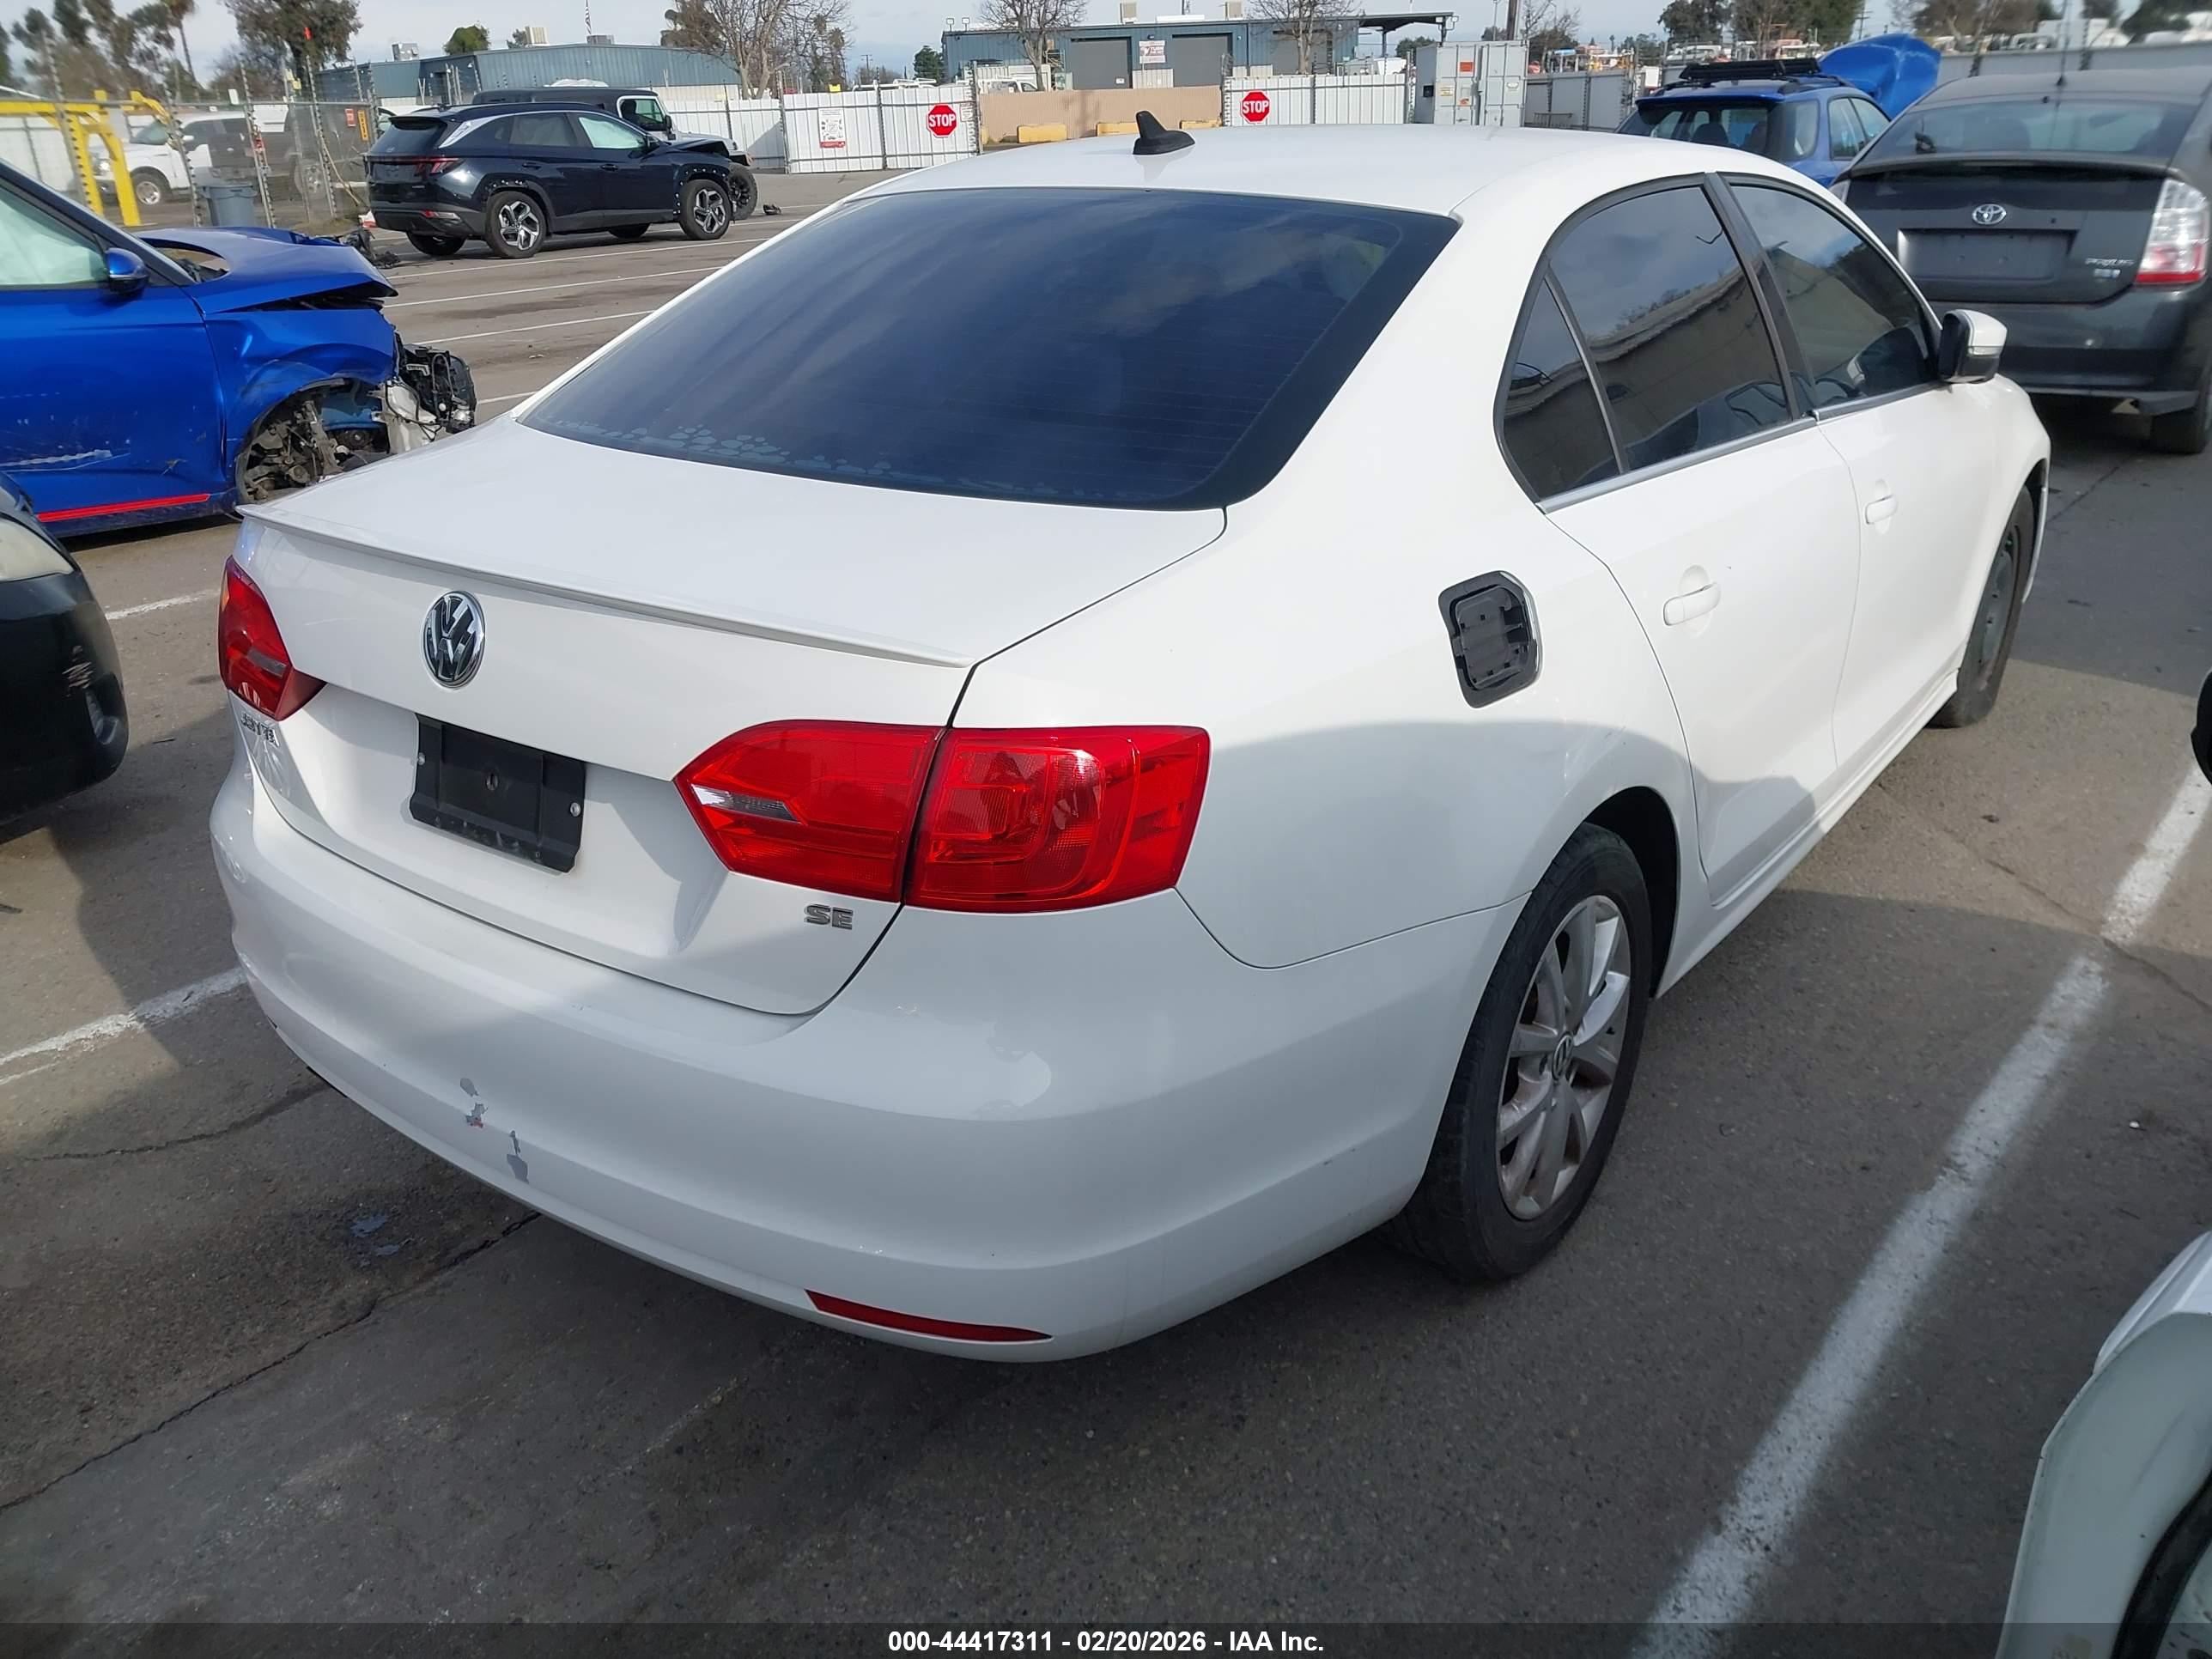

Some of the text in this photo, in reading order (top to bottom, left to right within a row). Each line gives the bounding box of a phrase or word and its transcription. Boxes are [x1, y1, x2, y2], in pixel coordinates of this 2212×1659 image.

[1243, 100, 1269, 113] STOP
[928, 113, 956, 127] STOP
[804, 903, 853, 930] SE
